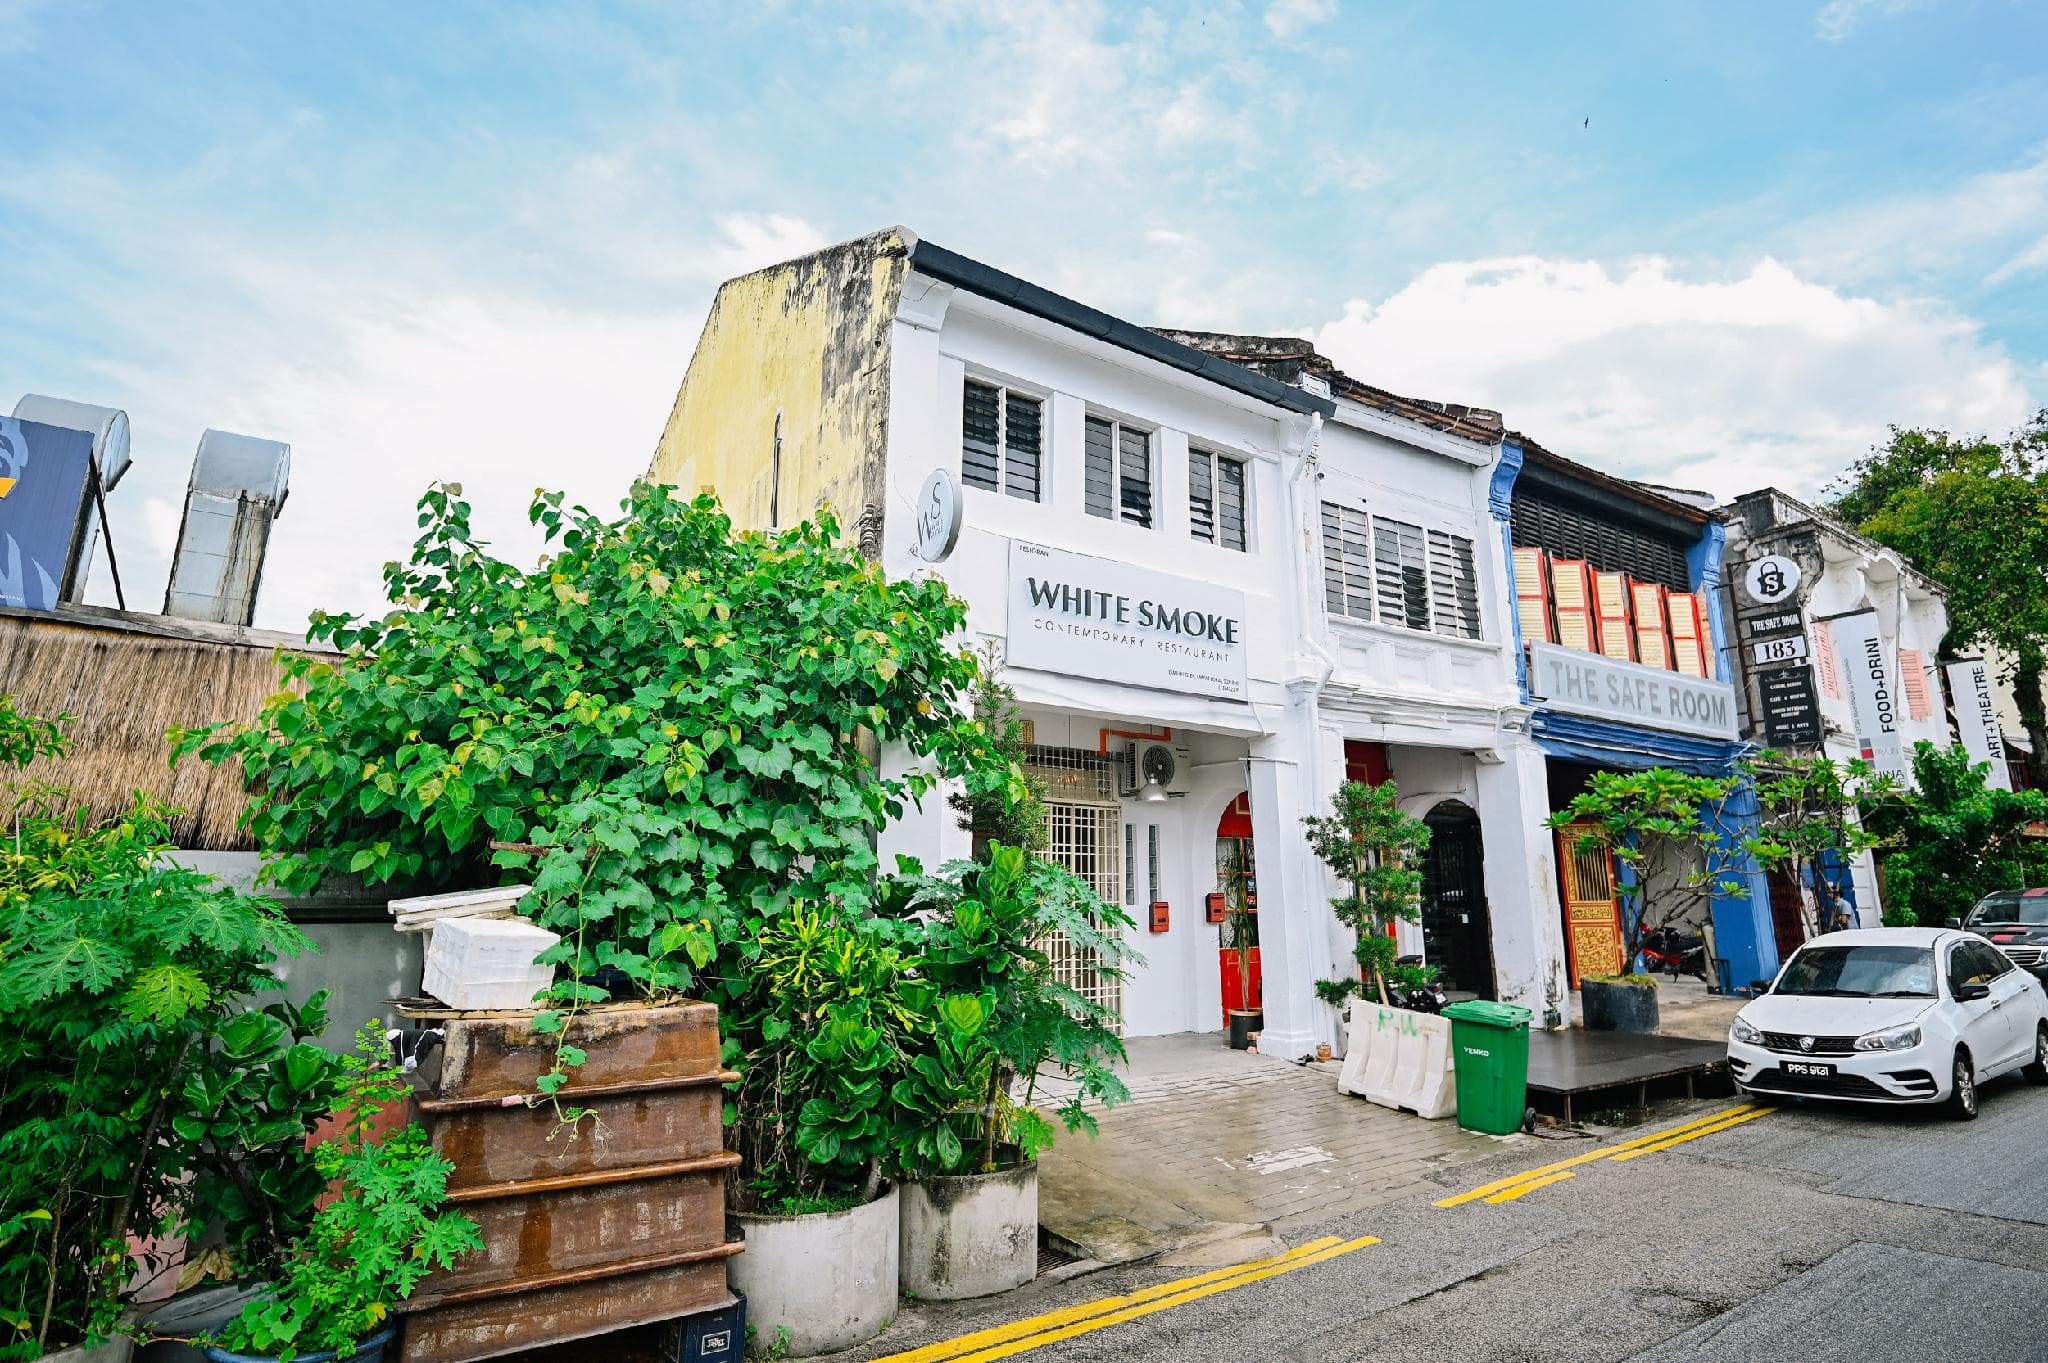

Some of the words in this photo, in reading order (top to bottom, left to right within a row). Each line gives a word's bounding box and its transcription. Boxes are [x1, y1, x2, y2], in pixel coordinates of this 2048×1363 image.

[1026, 577, 1130, 625] WHITE
[1136, 600, 1240, 645] SMOKE
[1034, 618, 1145, 648] CONTEMPORARY
[1157, 641, 1230, 663] RESTAURANT
[1764, 640, 1796, 660] 183
[1550, 660, 1599, 702] THE
[1606, 673, 1662, 715] SAFE
[1669, 685, 1728, 726] ROOM
[1972, 665, 2003, 760] ART+THEATRE
[1463, 1046, 1490, 1057] YENKO
[1787, 1063, 1809, 1075] PPS
[1809, 1065, 1829, 1077] 9131
